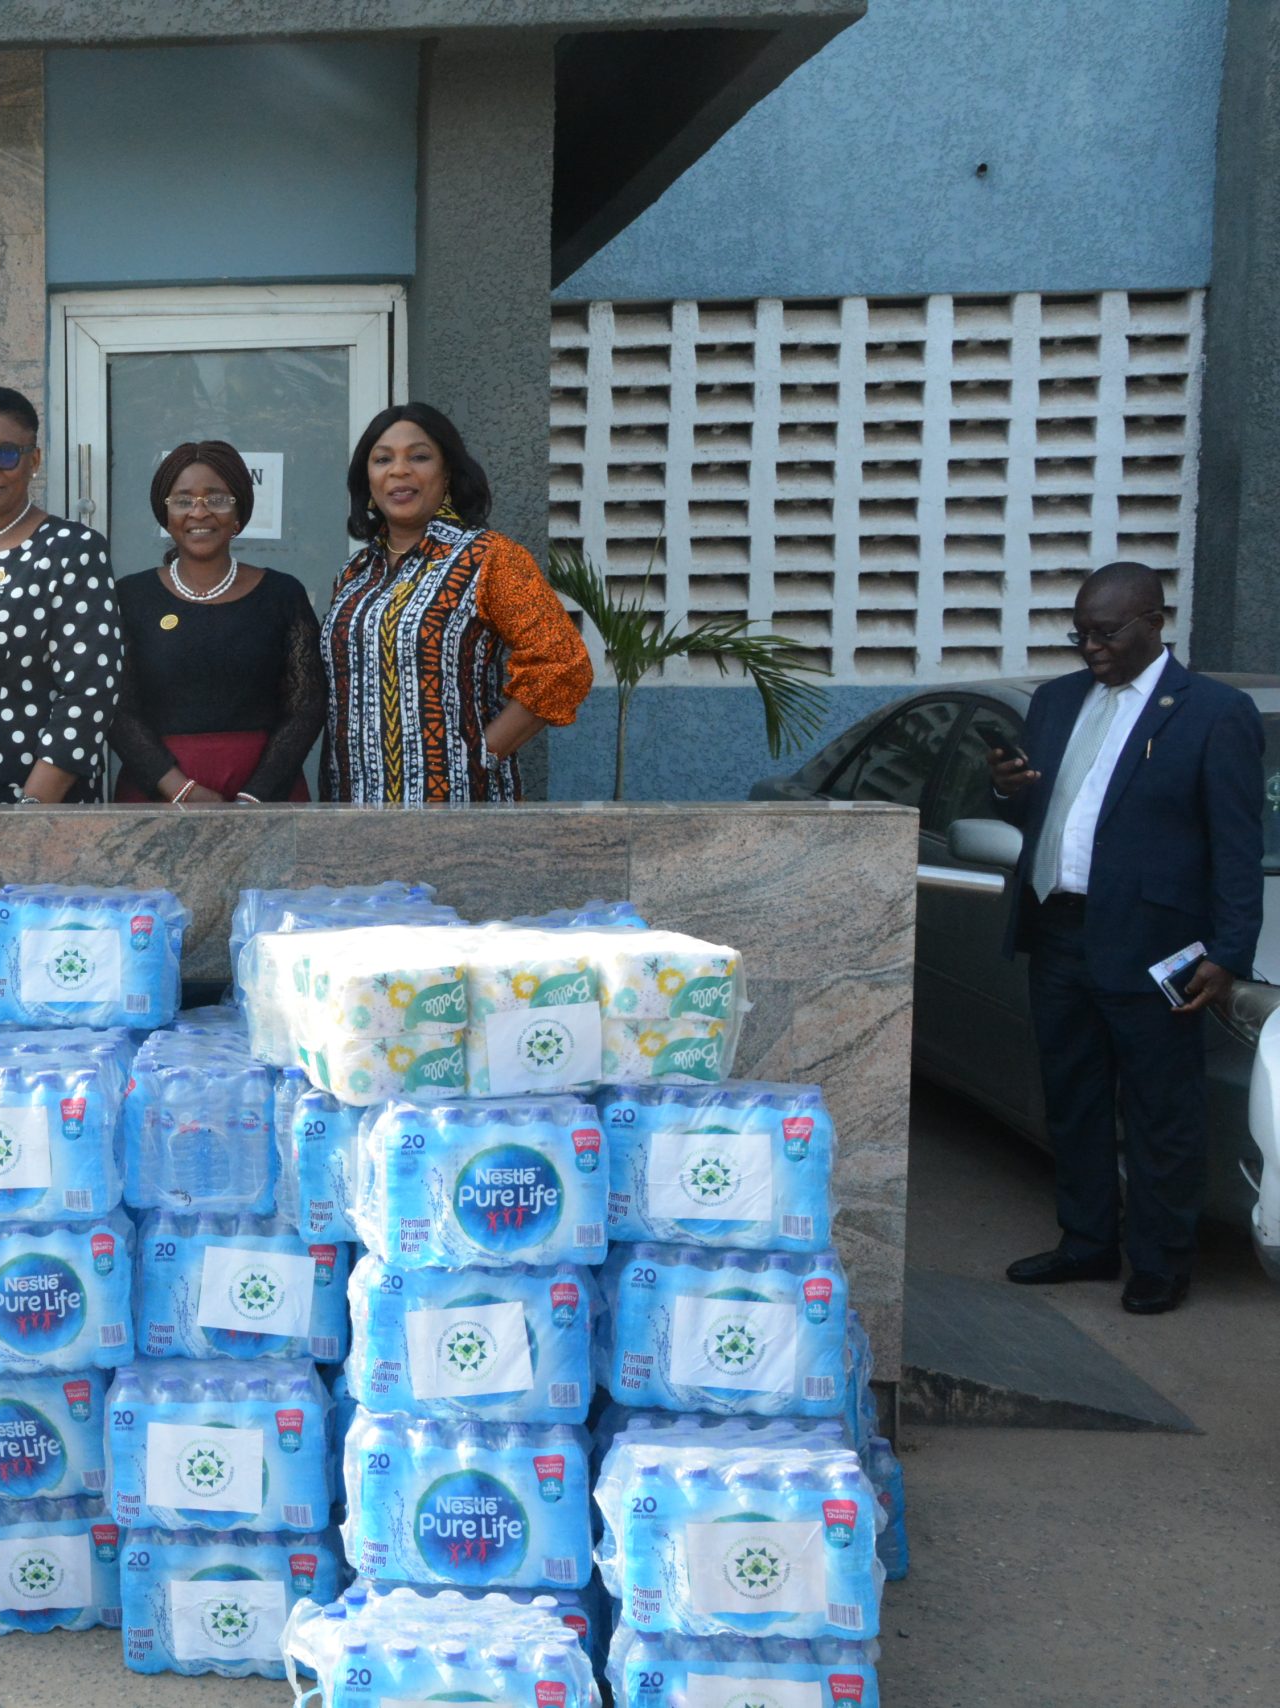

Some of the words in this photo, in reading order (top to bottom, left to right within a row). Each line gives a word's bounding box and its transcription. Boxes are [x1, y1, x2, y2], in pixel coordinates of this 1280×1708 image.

[421, 984, 465, 1017] Belle
[689, 982, 732, 1008] Belle
[671, 1044, 718, 1069] Belle
[421, 1049, 463, 1081] Belle
[612, 1108, 636, 1123] 20
[304, 1120, 326, 1136] 20
[401, 1134, 425, 1149] 20
[476, 1168, 537, 1185] Nestlé
[309, 1200, 334, 1209] Premium
[458, 1185, 515, 1208] Pure
[519, 1185, 558, 1215] Life
[608, 1193, 631, 1202] remium
[400, 1218, 431, 1228] Premium
[400, 1230, 429, 1241] Drinking
[155, 1242, 176, 1257] 20
[400, 1242, 420, 1252] Water
[4, 1274, 59, 1291] Nestlé
[380, 1275, 403, 1289] 20
[632, 1267, 657, 1283] 20
[45, 1289, 81, 1317] Life
[149, 1322, 175, 1333] Premium
[148, 1334, 173, 1346] Drinking
[146, 1345, 164, 1355] Water
[375, 1359, 401, 1371] Premium
[623, 1351, 654, 1365] Premium
[372, 1370, 399, 1383] Drinking
[622, 1364, 651, 1379] Drinking
[621, 1377, 642, 1390] Water
[113, 1410, 134, 1425] 20
[25, 1435, 61, 1464] Life
[367, 1453, 390, 1469] 20
[538, 1466, 562, 1475] Quality
[116, 1491, 141, 1503] Premium
[436, 1496, 498, 1515] Nestlé
[632, 1496, 658, 1514] 20
[826, 1513, 855, 1522] Quality
[419, 1514, 477, 1538] Pure
[481, 1516, 523, 1547] Life
[363, 1538, 389, 1553] Premium
[128, 1551, 150, 1566] 20
[632, 1583, 662, 1599] Premium
[632, 1598, 661, 1613] Drinking
[631, 1611, 652, 1625] Water
[128, 1627, 154, 1637] Premium
[128, 1639, 153, 1650] Drinking
[128, 1650, 145, 1661] Water
[346, 1668, 372, 1686] 20
[639, 1671, 664, 1688] 20
[833, 1687, 861, 1696] Quality
